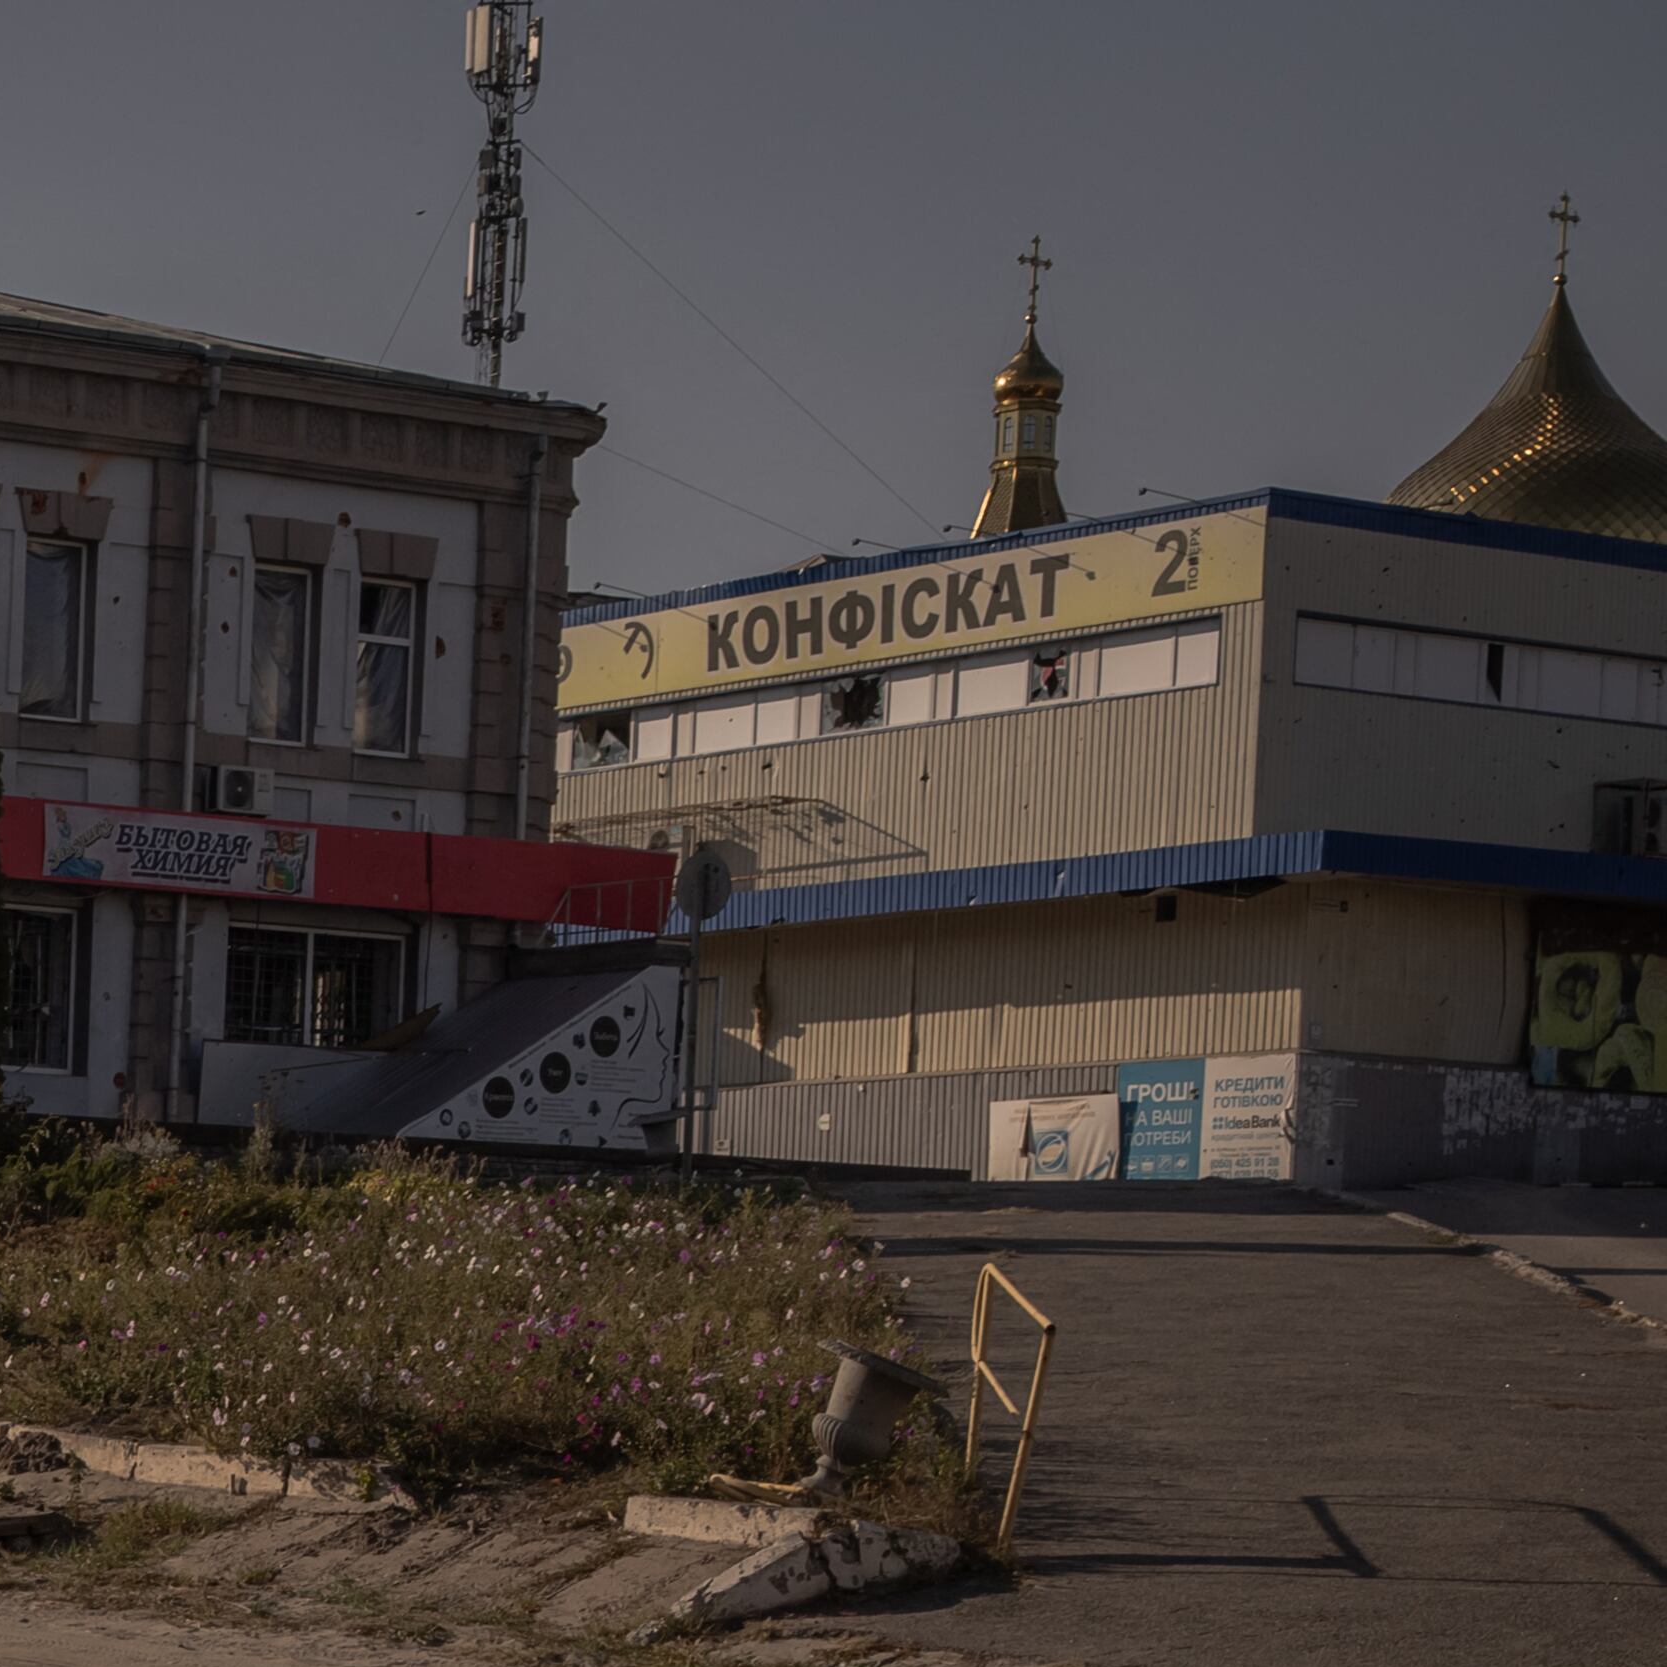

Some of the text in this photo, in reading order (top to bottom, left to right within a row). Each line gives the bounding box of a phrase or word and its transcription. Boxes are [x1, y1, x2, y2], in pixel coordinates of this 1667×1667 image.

[1187, 526, 1202, 591] ПОЕРХ
[707, 529, 1188, 672] КОНФІСКАТ 2
[116, 824, 249, 857] БЫТОВАЯ
[131, 849, 232, 877] ХИМИЯ
[1214, 1076, 1285, 1094] КРЕДИТИ
[1213, 1093, 1284, 1109] ГОТІВКОЮ
[1125, 1108, 1192, 1128] НА ВАШІ
[1124, 1130, 1192, 1147] ПОТРЕБИ
